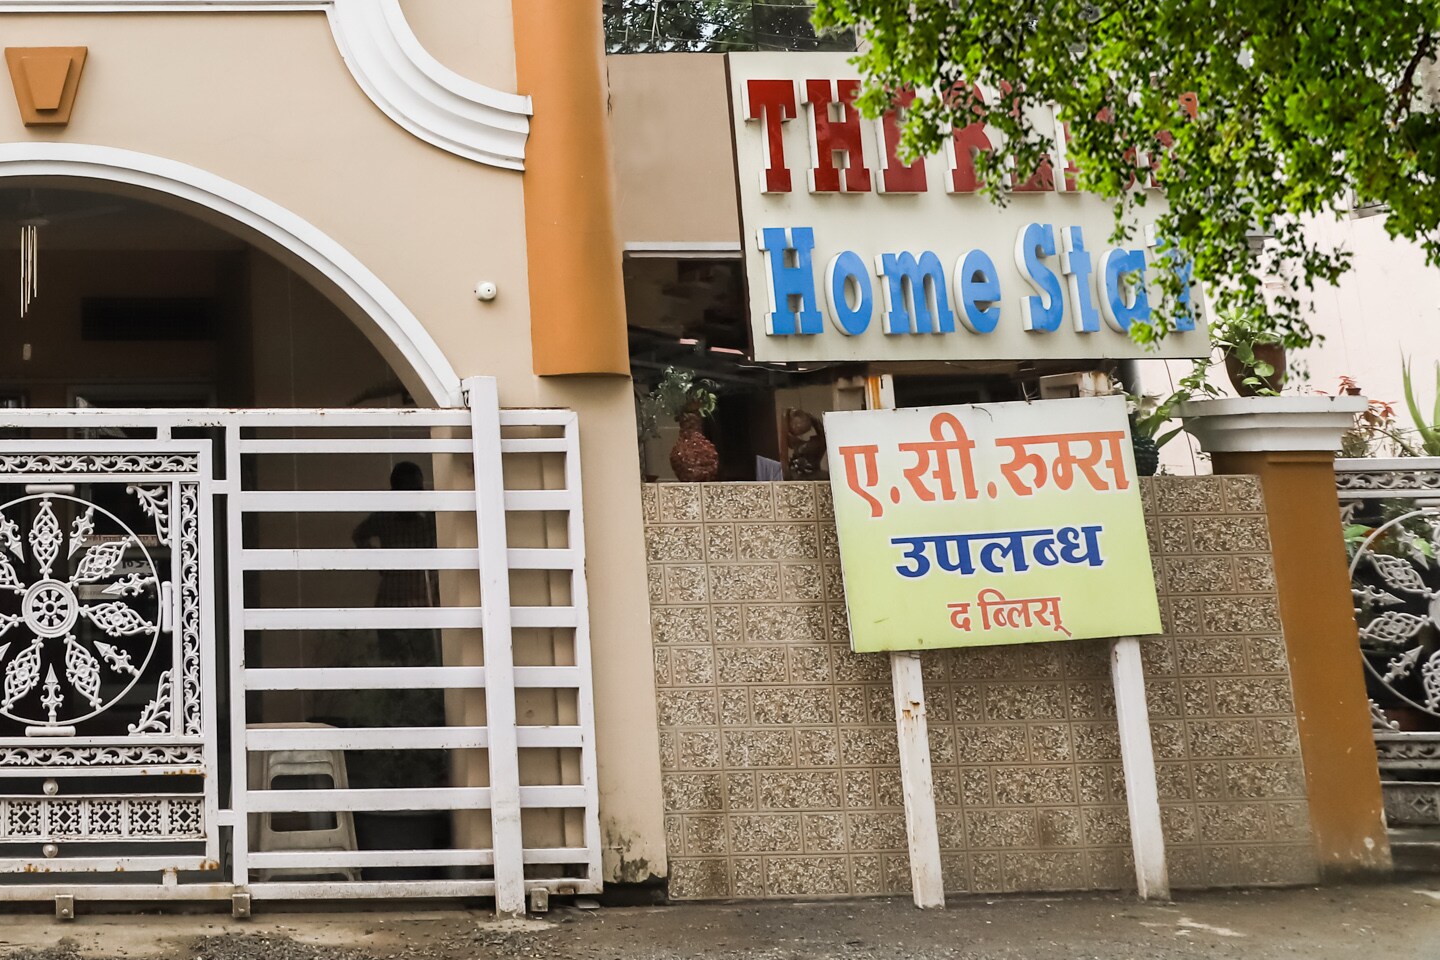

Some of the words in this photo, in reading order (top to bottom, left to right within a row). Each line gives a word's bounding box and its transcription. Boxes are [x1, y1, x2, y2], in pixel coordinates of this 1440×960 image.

[757, 226, 1002, 336] Home
[891, 525, 1104, 578] उपलब्ध
[947, 603, 971, 632] द
[977, 588, 1072, 637] ब्लिस्
